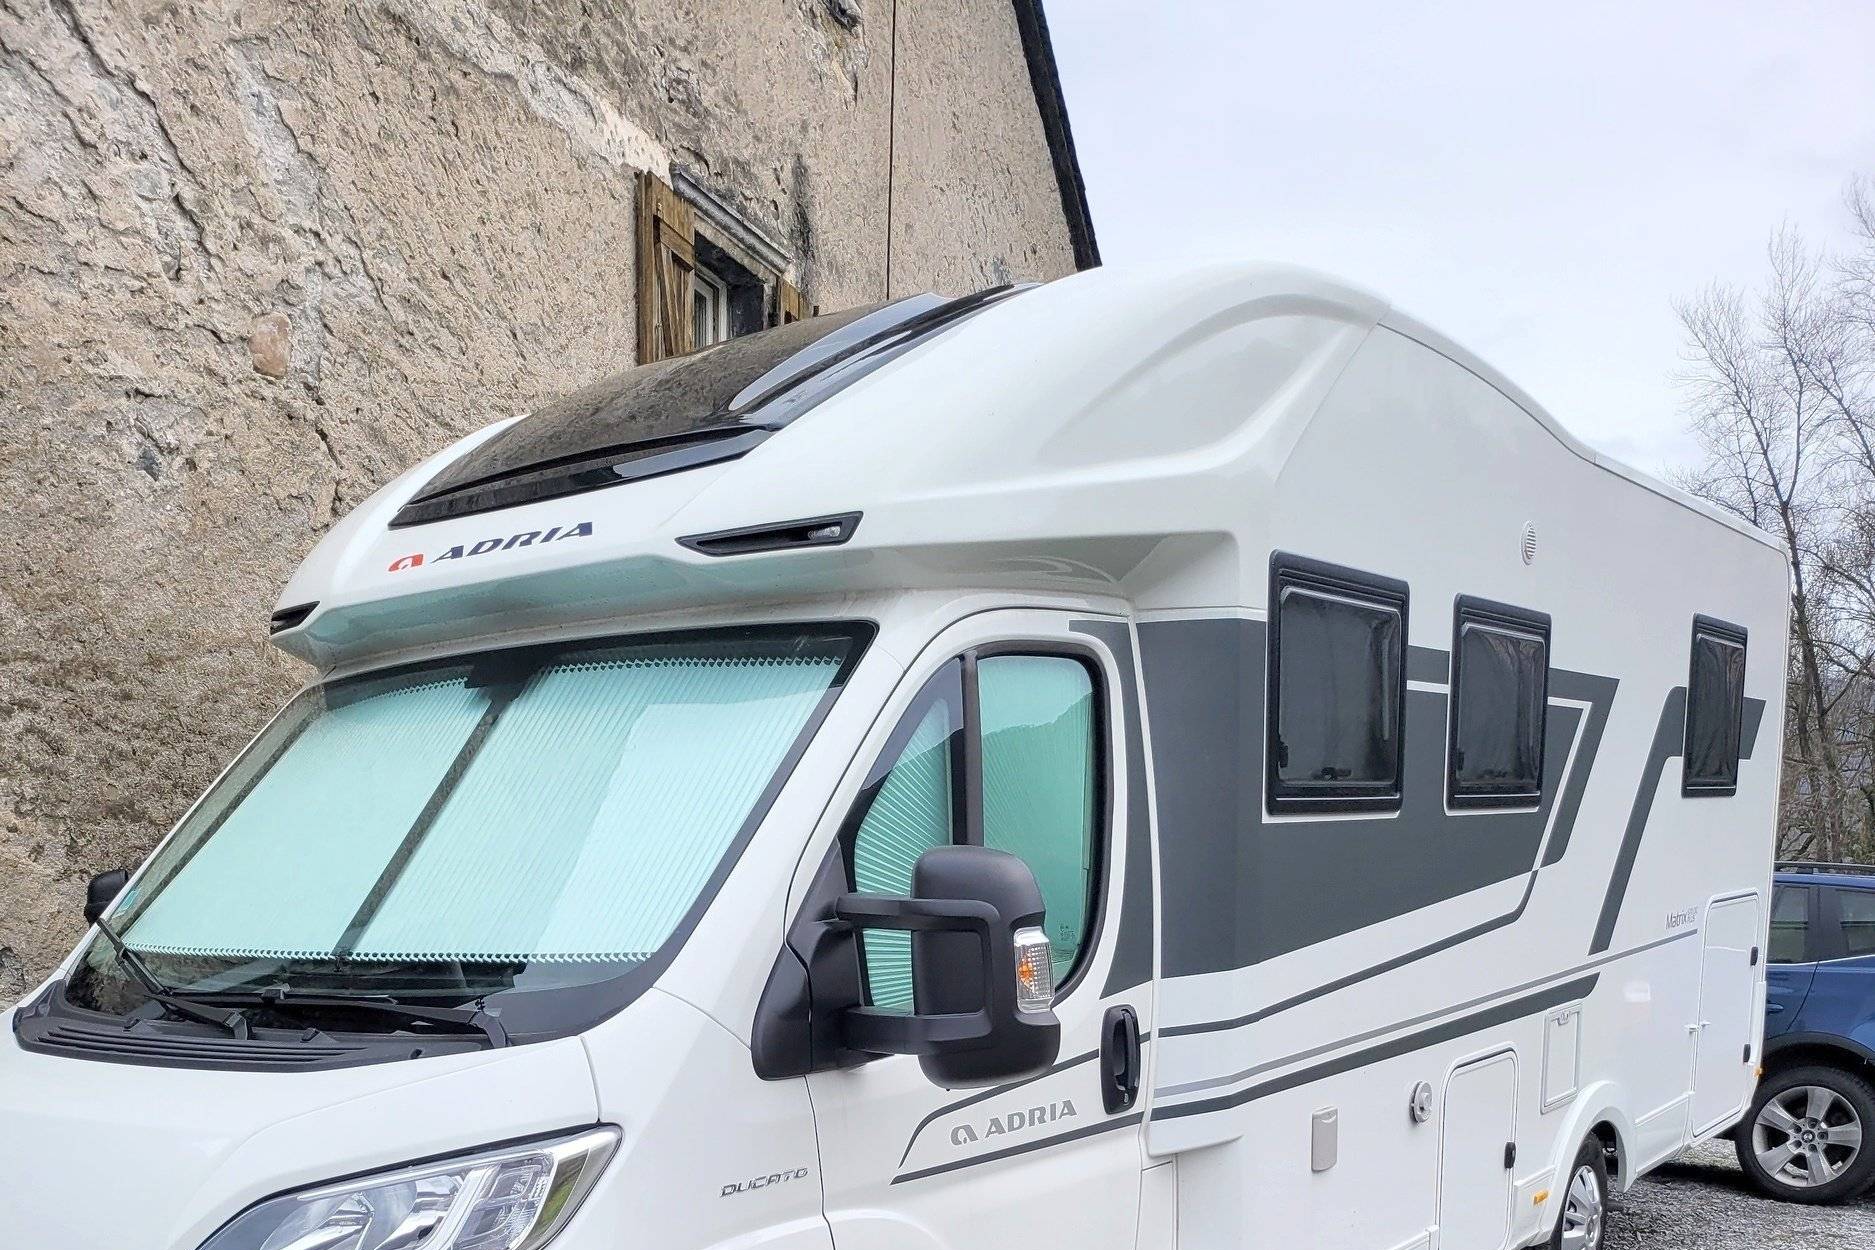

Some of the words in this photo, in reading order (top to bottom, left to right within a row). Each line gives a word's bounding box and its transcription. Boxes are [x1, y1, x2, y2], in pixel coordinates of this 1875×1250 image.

[430, 521, 593, 564] ADRIA
[984, 1099, 1077, 1139] ADRIA
[719, 1167, 808, 1198] DUCATO
